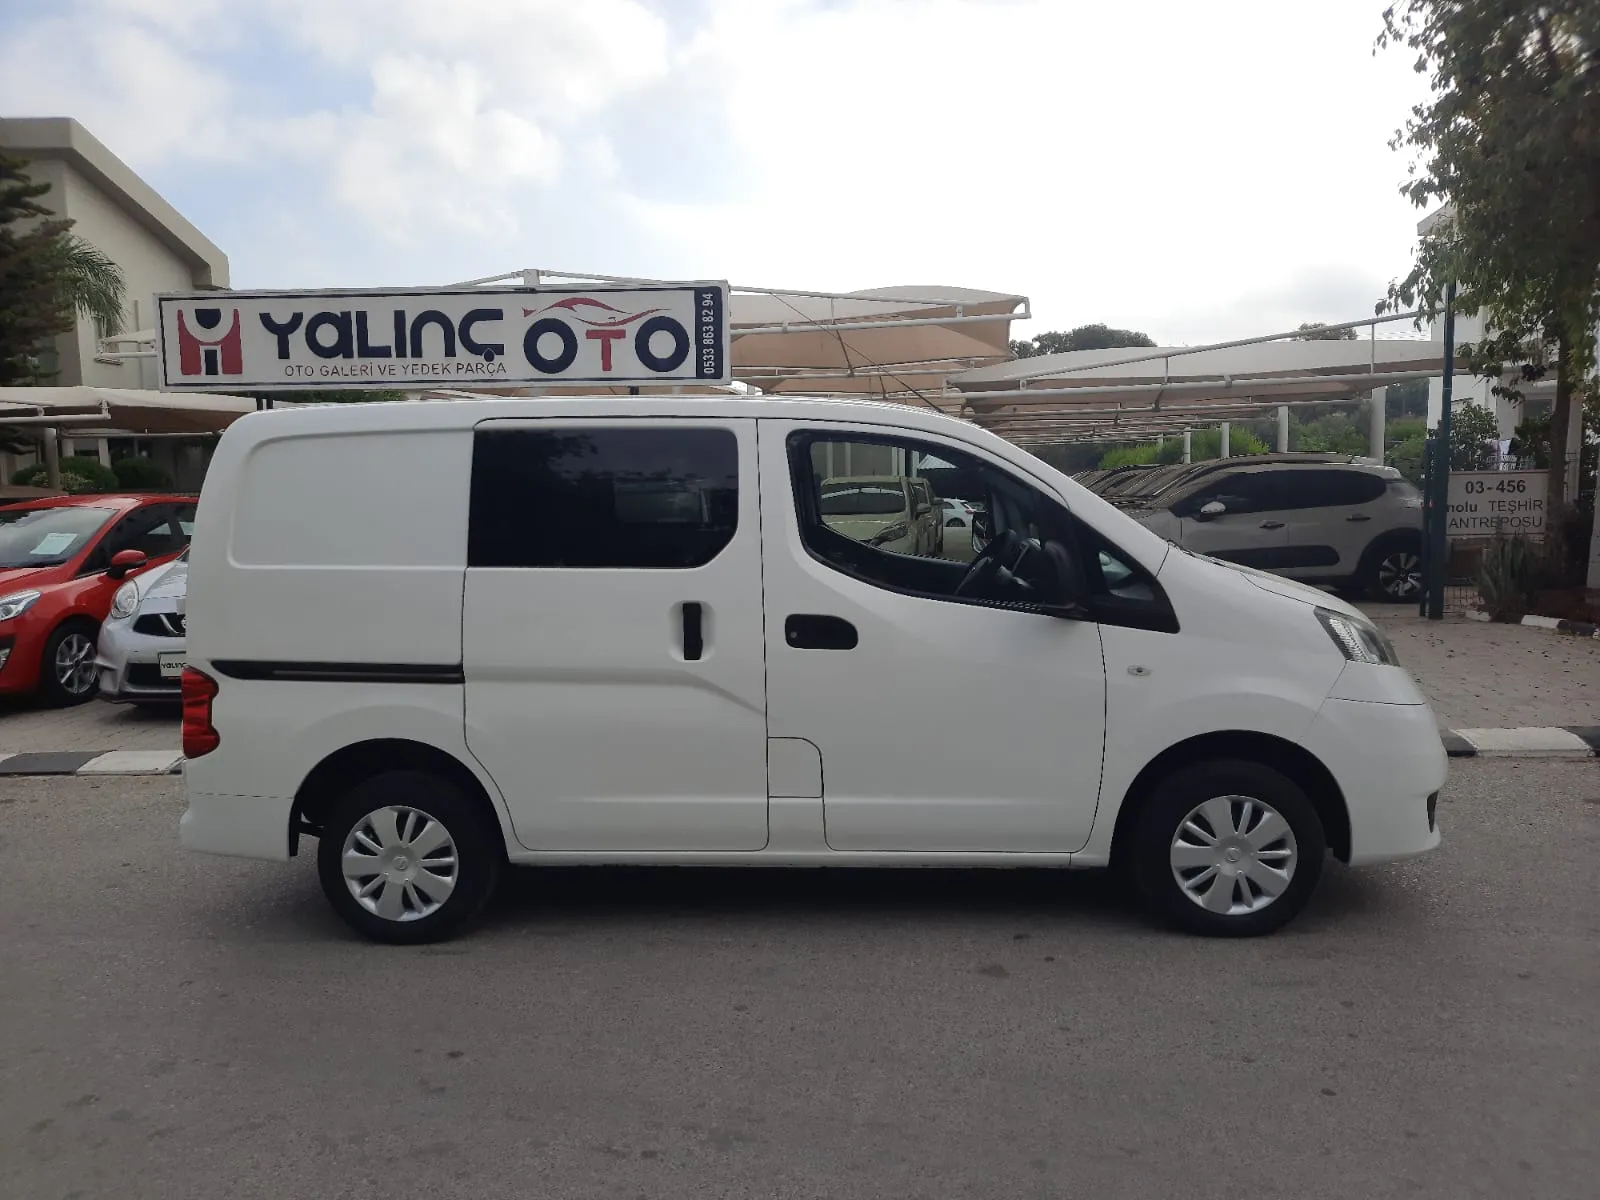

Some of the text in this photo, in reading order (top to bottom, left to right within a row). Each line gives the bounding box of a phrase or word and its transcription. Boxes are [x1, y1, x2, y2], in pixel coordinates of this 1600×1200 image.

[702, 293, 715, 374] 0533 863 82 94
[523, 316, 690, 374] OTO
[284, 361, 507, 377] OTO GALERİ VE YEDEK PARÇA
[1465, 479, 1526, 494] 03-456
[1488, 496, 1544, 514] TEŞHİR
[1448, 516, 1542, 529] ANTREPOSU
